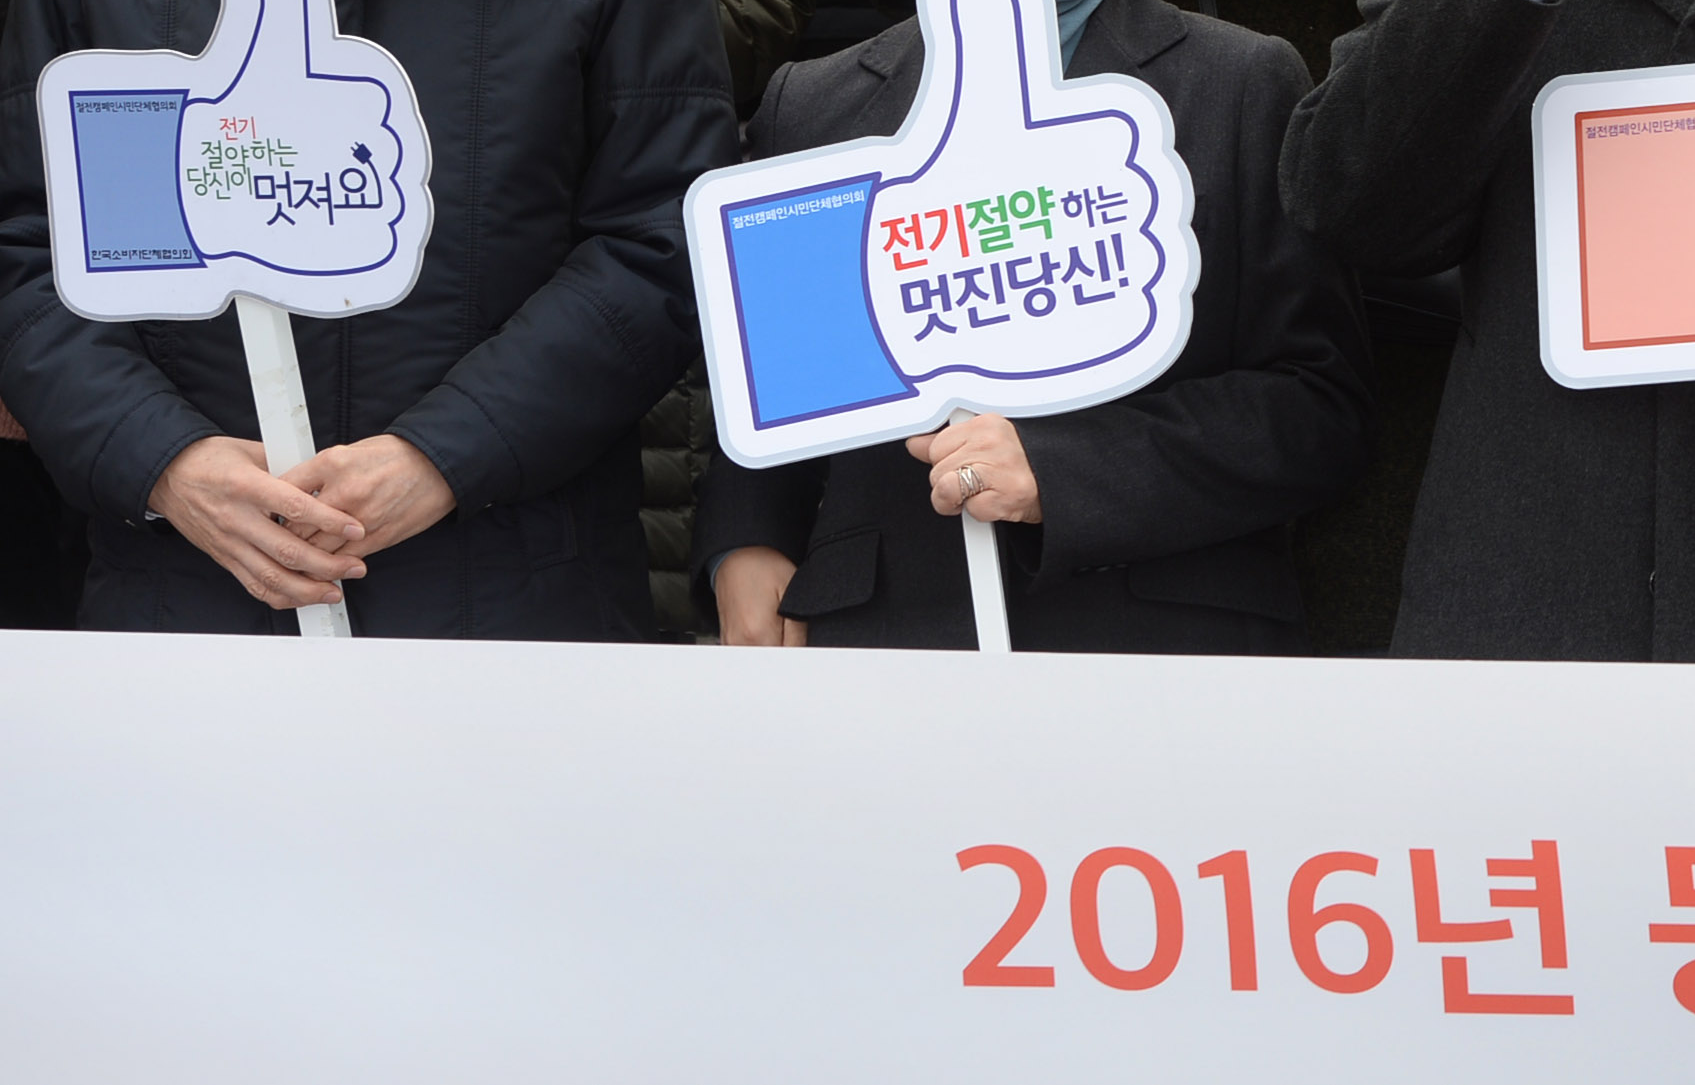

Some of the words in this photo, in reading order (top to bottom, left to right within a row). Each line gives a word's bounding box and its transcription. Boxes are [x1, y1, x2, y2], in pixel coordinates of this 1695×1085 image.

[219, 116, 256, 141] 전기
[201, 138, 298, 174] 절약하는
[186, 166, 253, 200] 당신이
[253, 170, 383, 226] 멋져요
[732, 189, 866, 230] 절전캠페인시민단체협의회
[880, 186, 1055, 271] 전기절약
[1060, 185, 1129, 228] 하는
[91, 249, 193, 261] 한국소비자단체협의회
[899, 233, 1130, 343] 멋진당신!
[956, 839, 1575, 1016] 2016년
